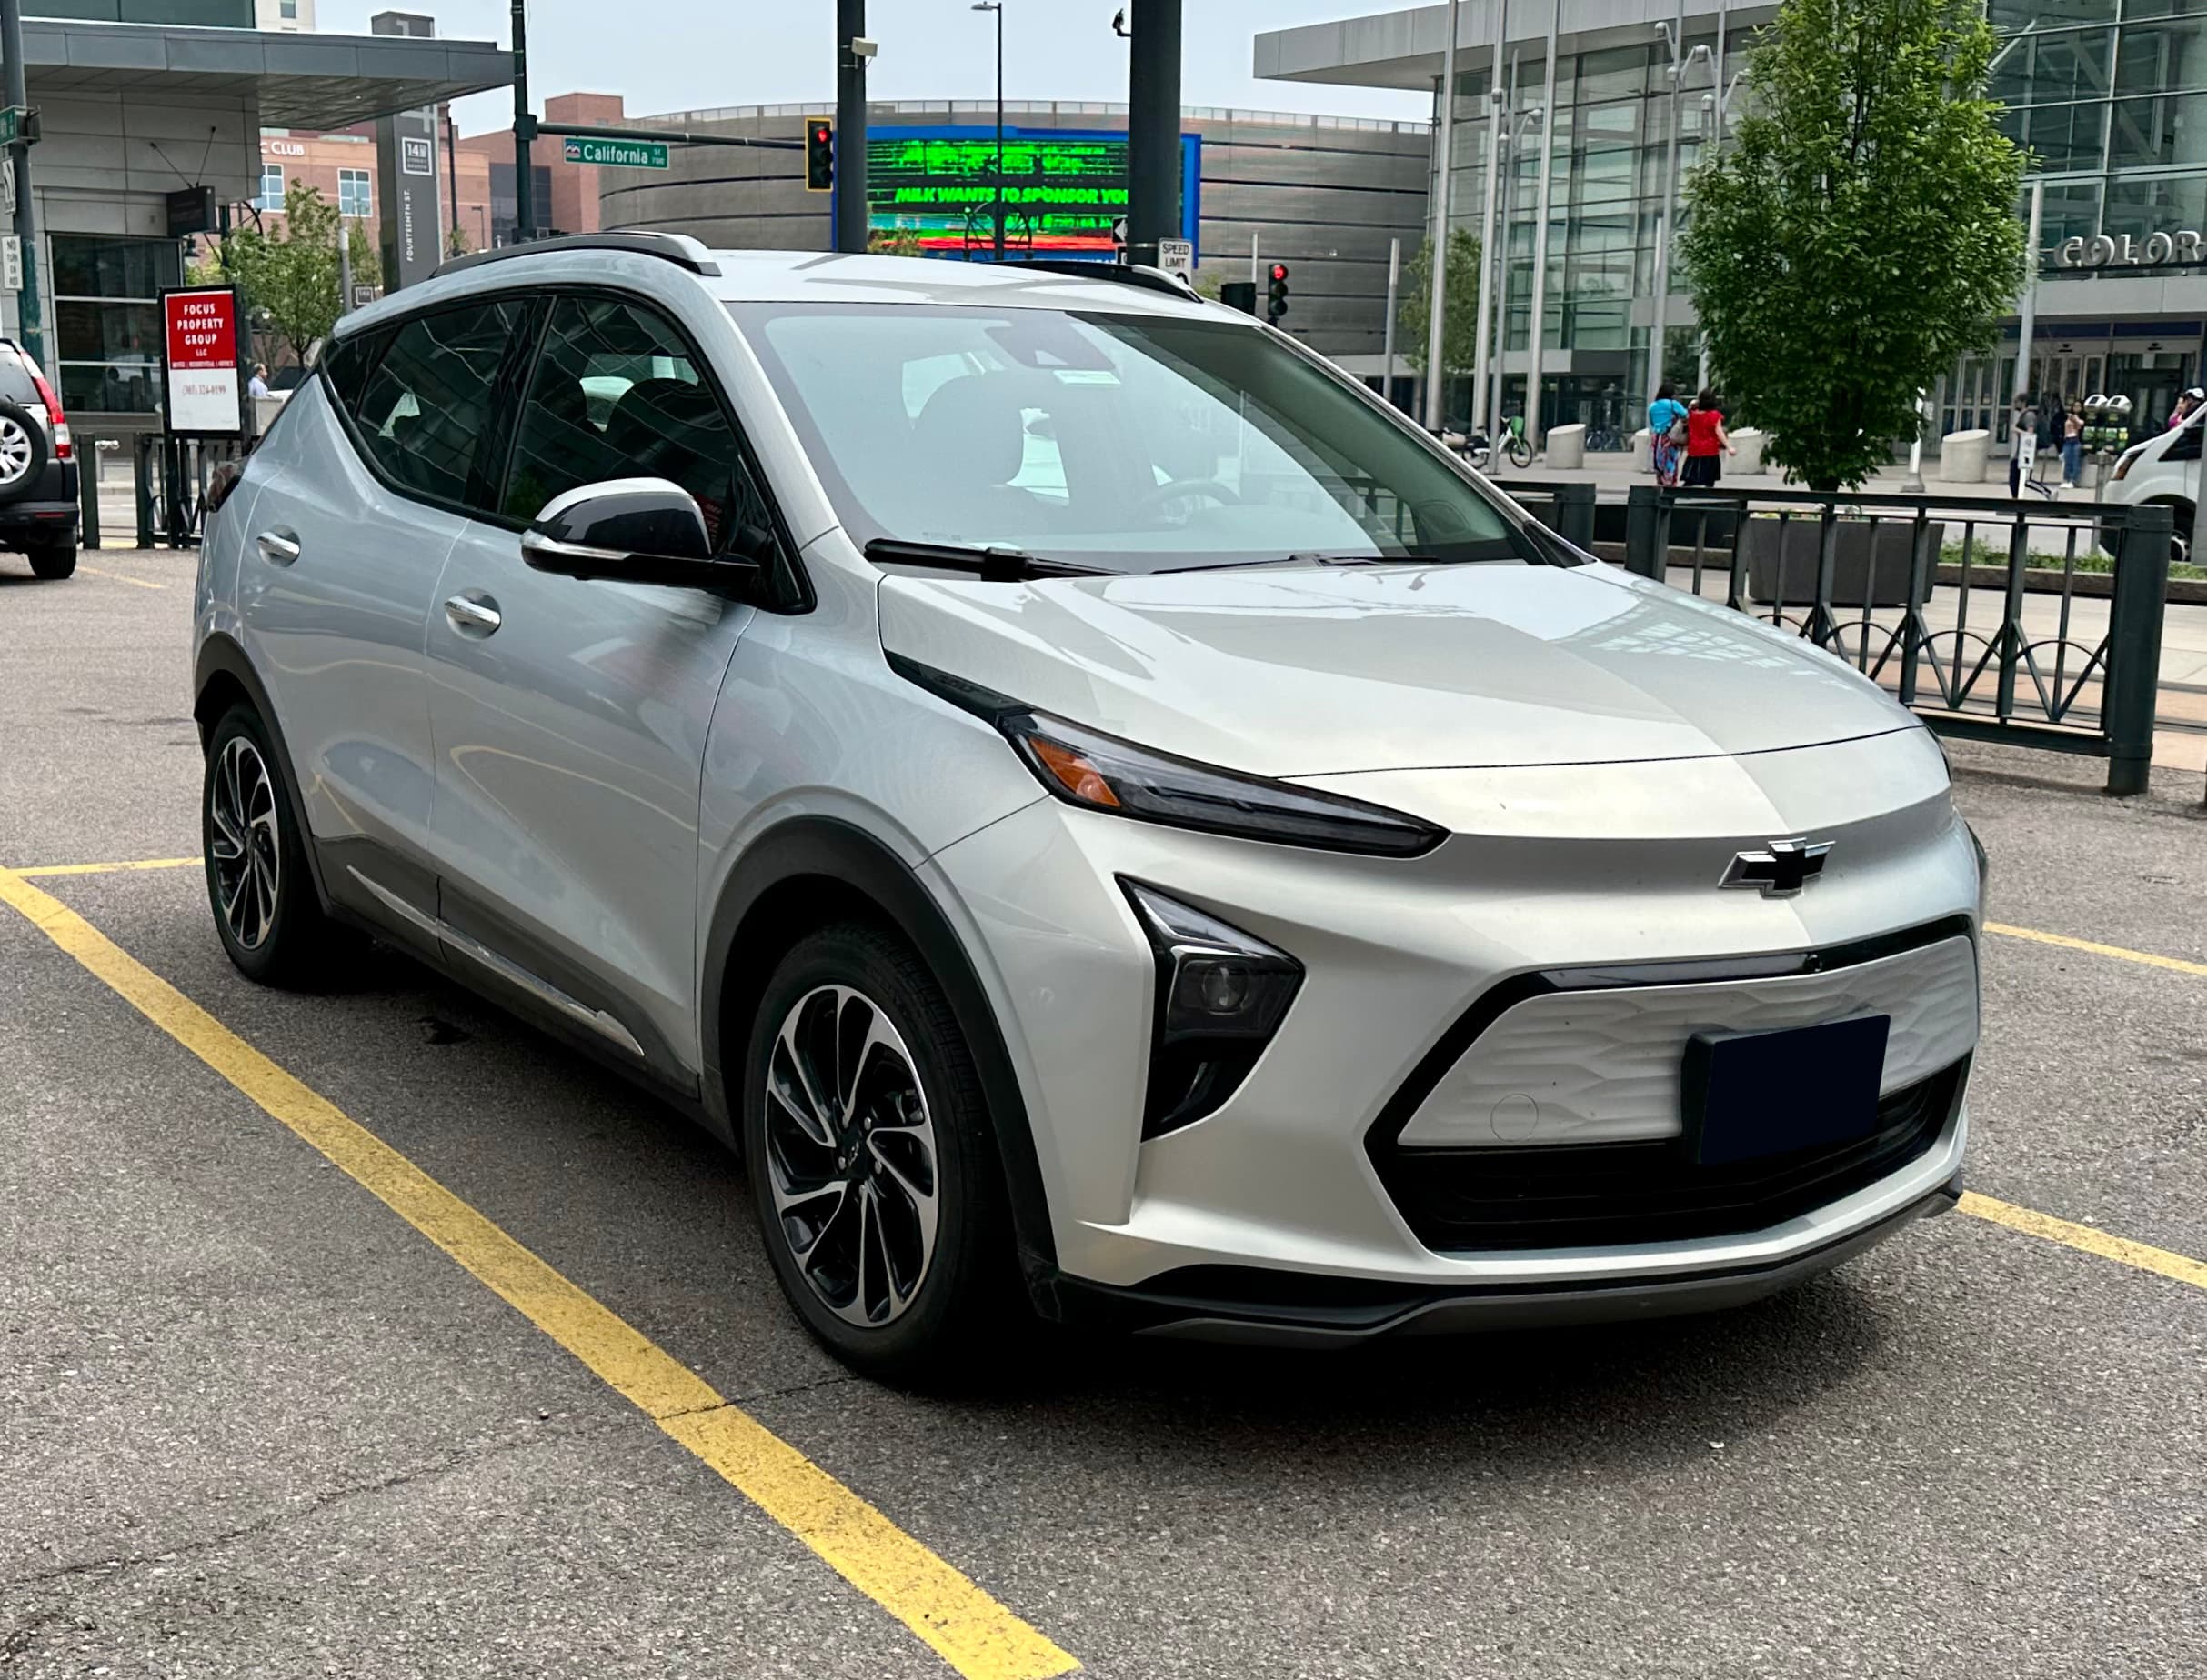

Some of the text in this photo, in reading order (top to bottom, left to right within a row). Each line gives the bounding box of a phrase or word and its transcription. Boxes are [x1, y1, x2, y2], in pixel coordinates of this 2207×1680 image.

[271, 141, 305, 155] CLUB
[583, 145, 648, 164] California
[895, 187, 936, 202] MILK
[938, 187, 996, 202] WANTS
[1021, 187, 1098, 203] SPONSOR
[405, 203, 413, 262] FOURTEENTH
[1162, 243, 1189, 255] SPEED
[1165, 257, 1186, 267] LIMIT
[184, 304, 216, 315] FOCUS
[176, 318, 224, 331] PROPERTY
[185, 334, 217, 345] GROUP
